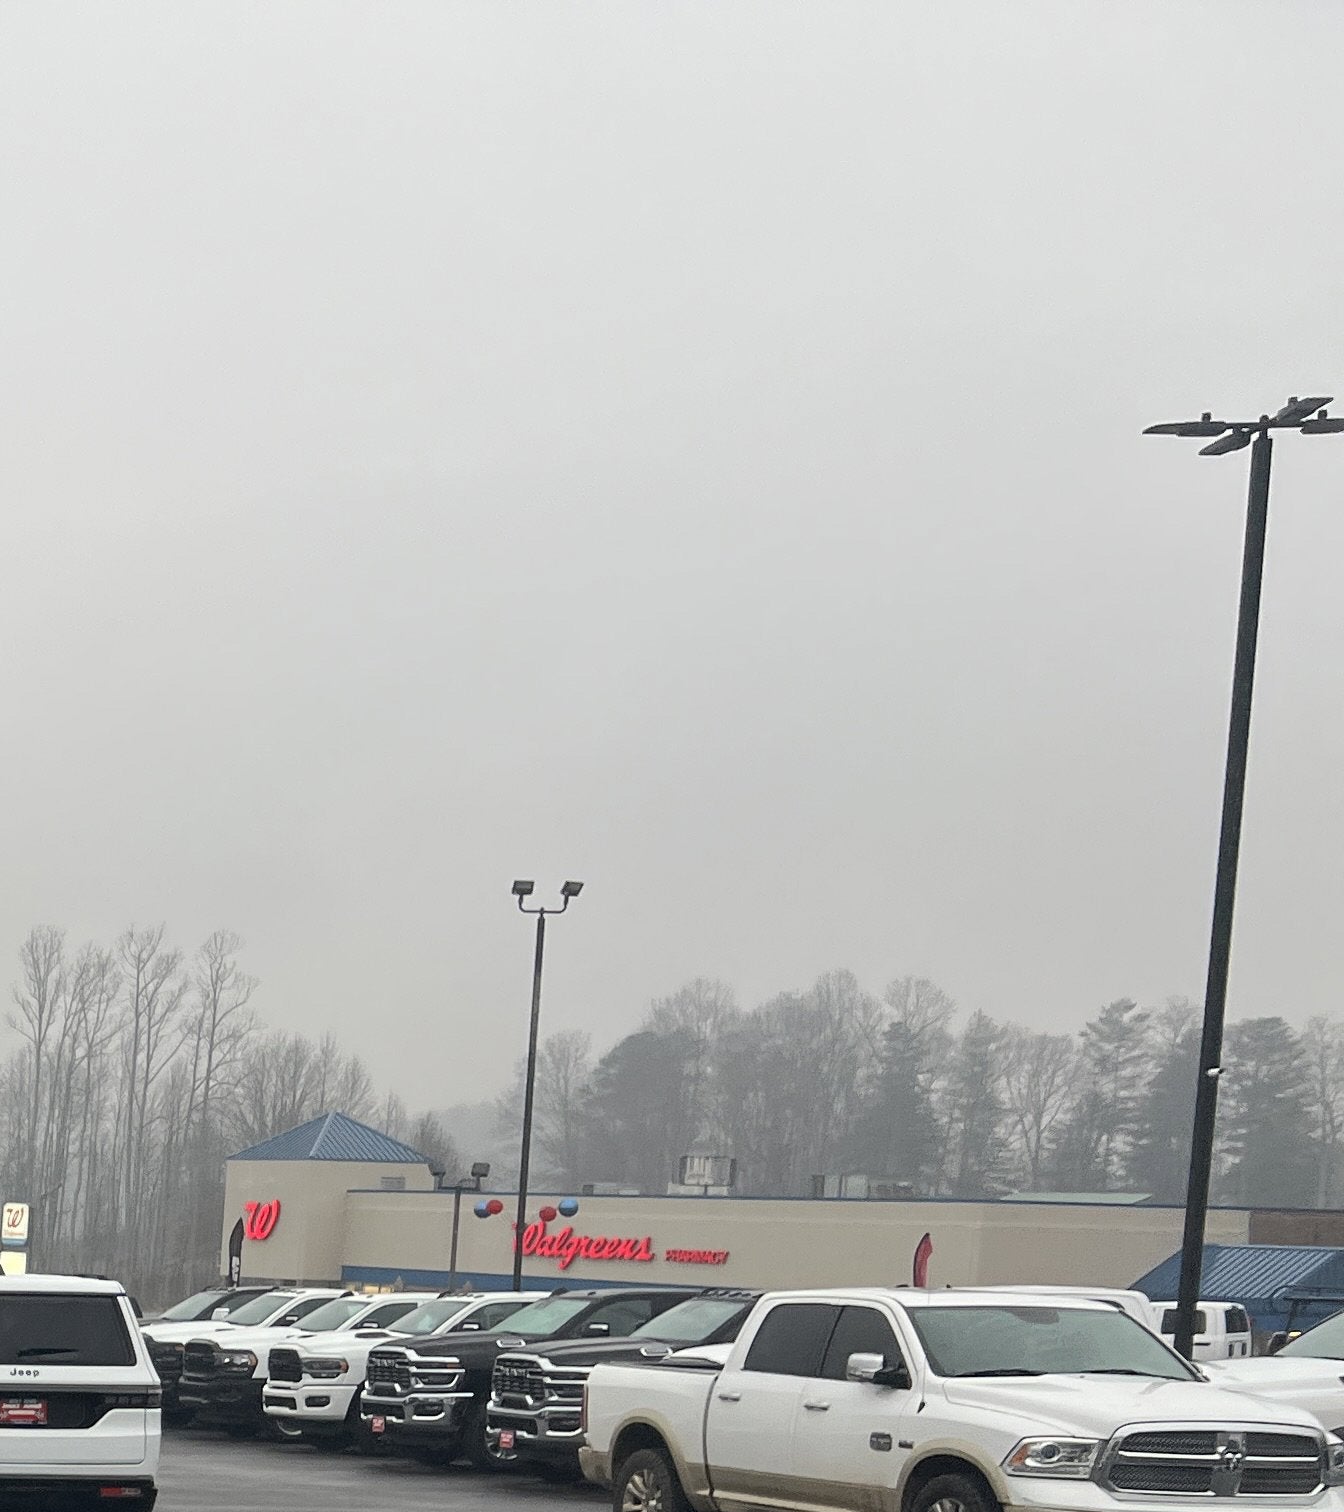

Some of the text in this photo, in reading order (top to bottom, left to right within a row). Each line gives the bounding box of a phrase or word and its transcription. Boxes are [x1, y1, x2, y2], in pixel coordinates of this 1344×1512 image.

[6, 1208, 25, 1228] W
[245, 1199, 281, 1240] W
[513, 1220, 730, 1271] Walgreens PHARMACY
[9, 1367, 40, 1378] Jeep
